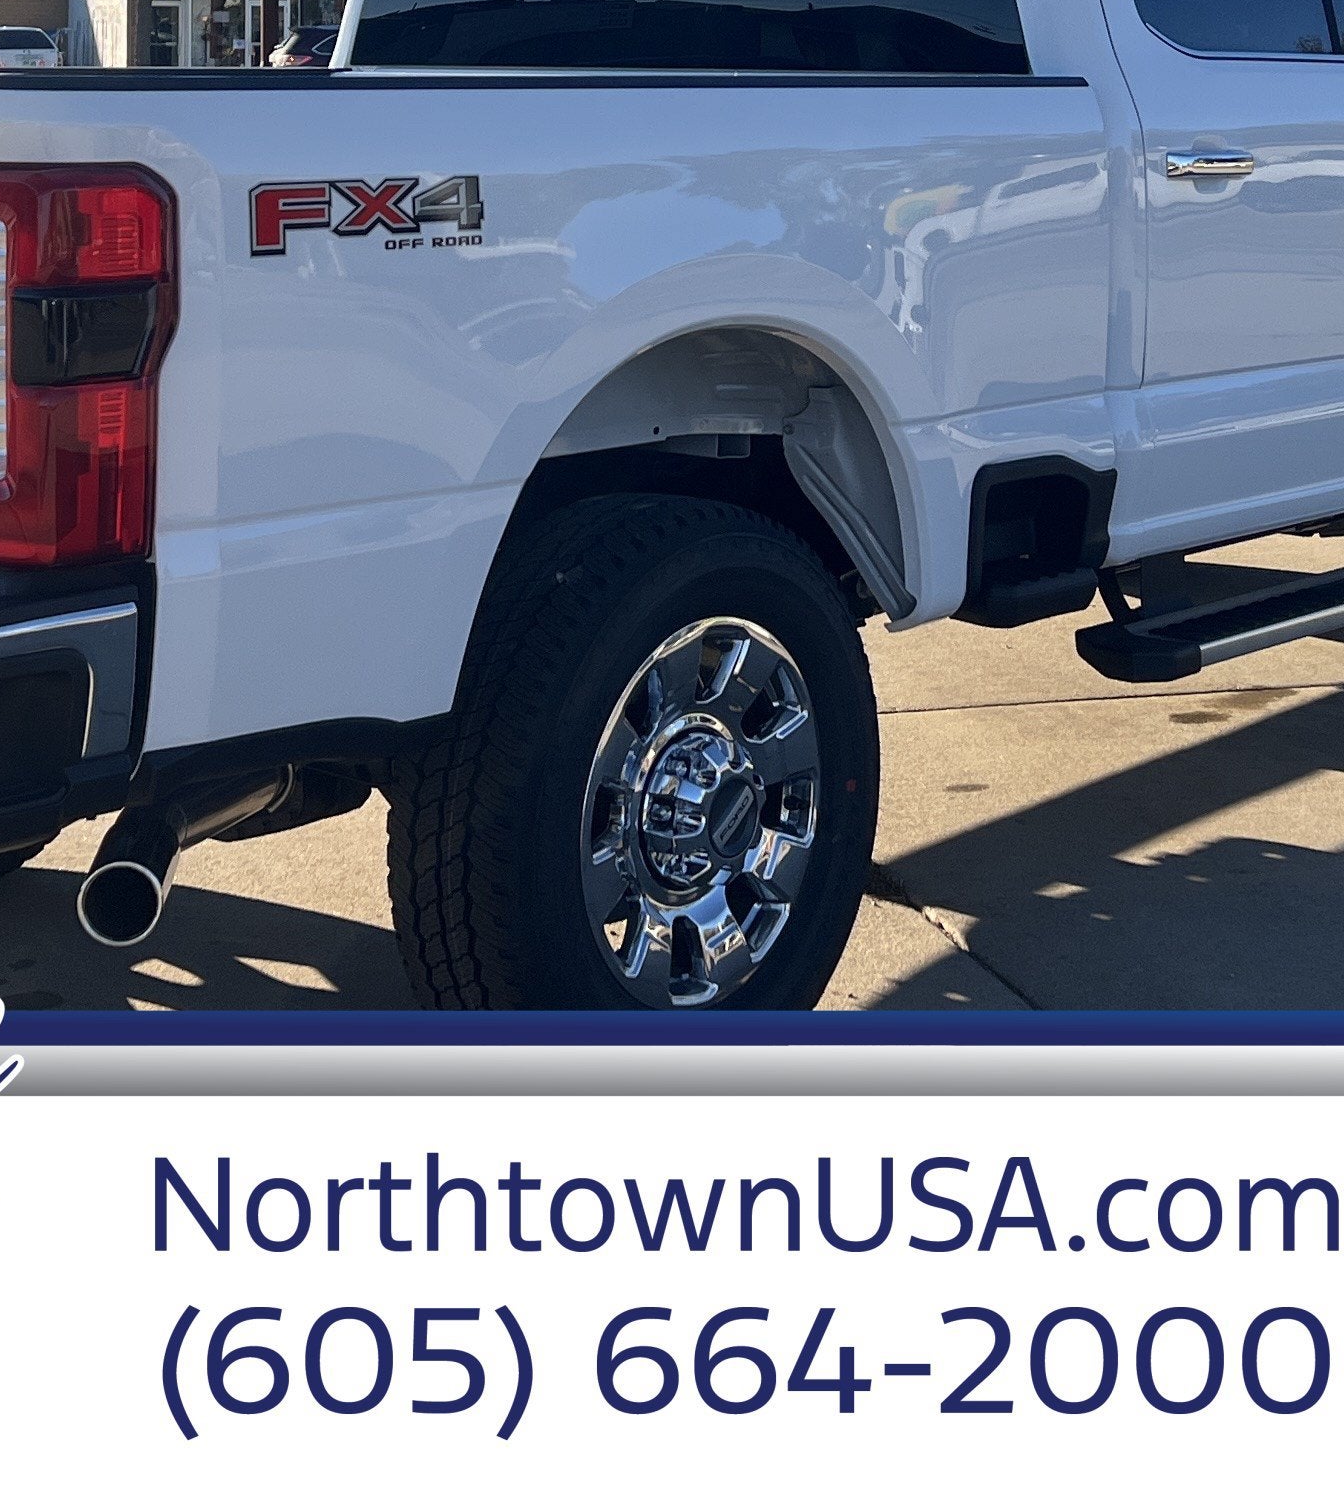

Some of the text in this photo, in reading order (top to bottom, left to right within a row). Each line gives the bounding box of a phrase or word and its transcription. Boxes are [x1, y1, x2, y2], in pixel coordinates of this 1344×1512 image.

[249, 175, 484, 257] FX4
[385, 235, 483, 250] OFF ROAD
